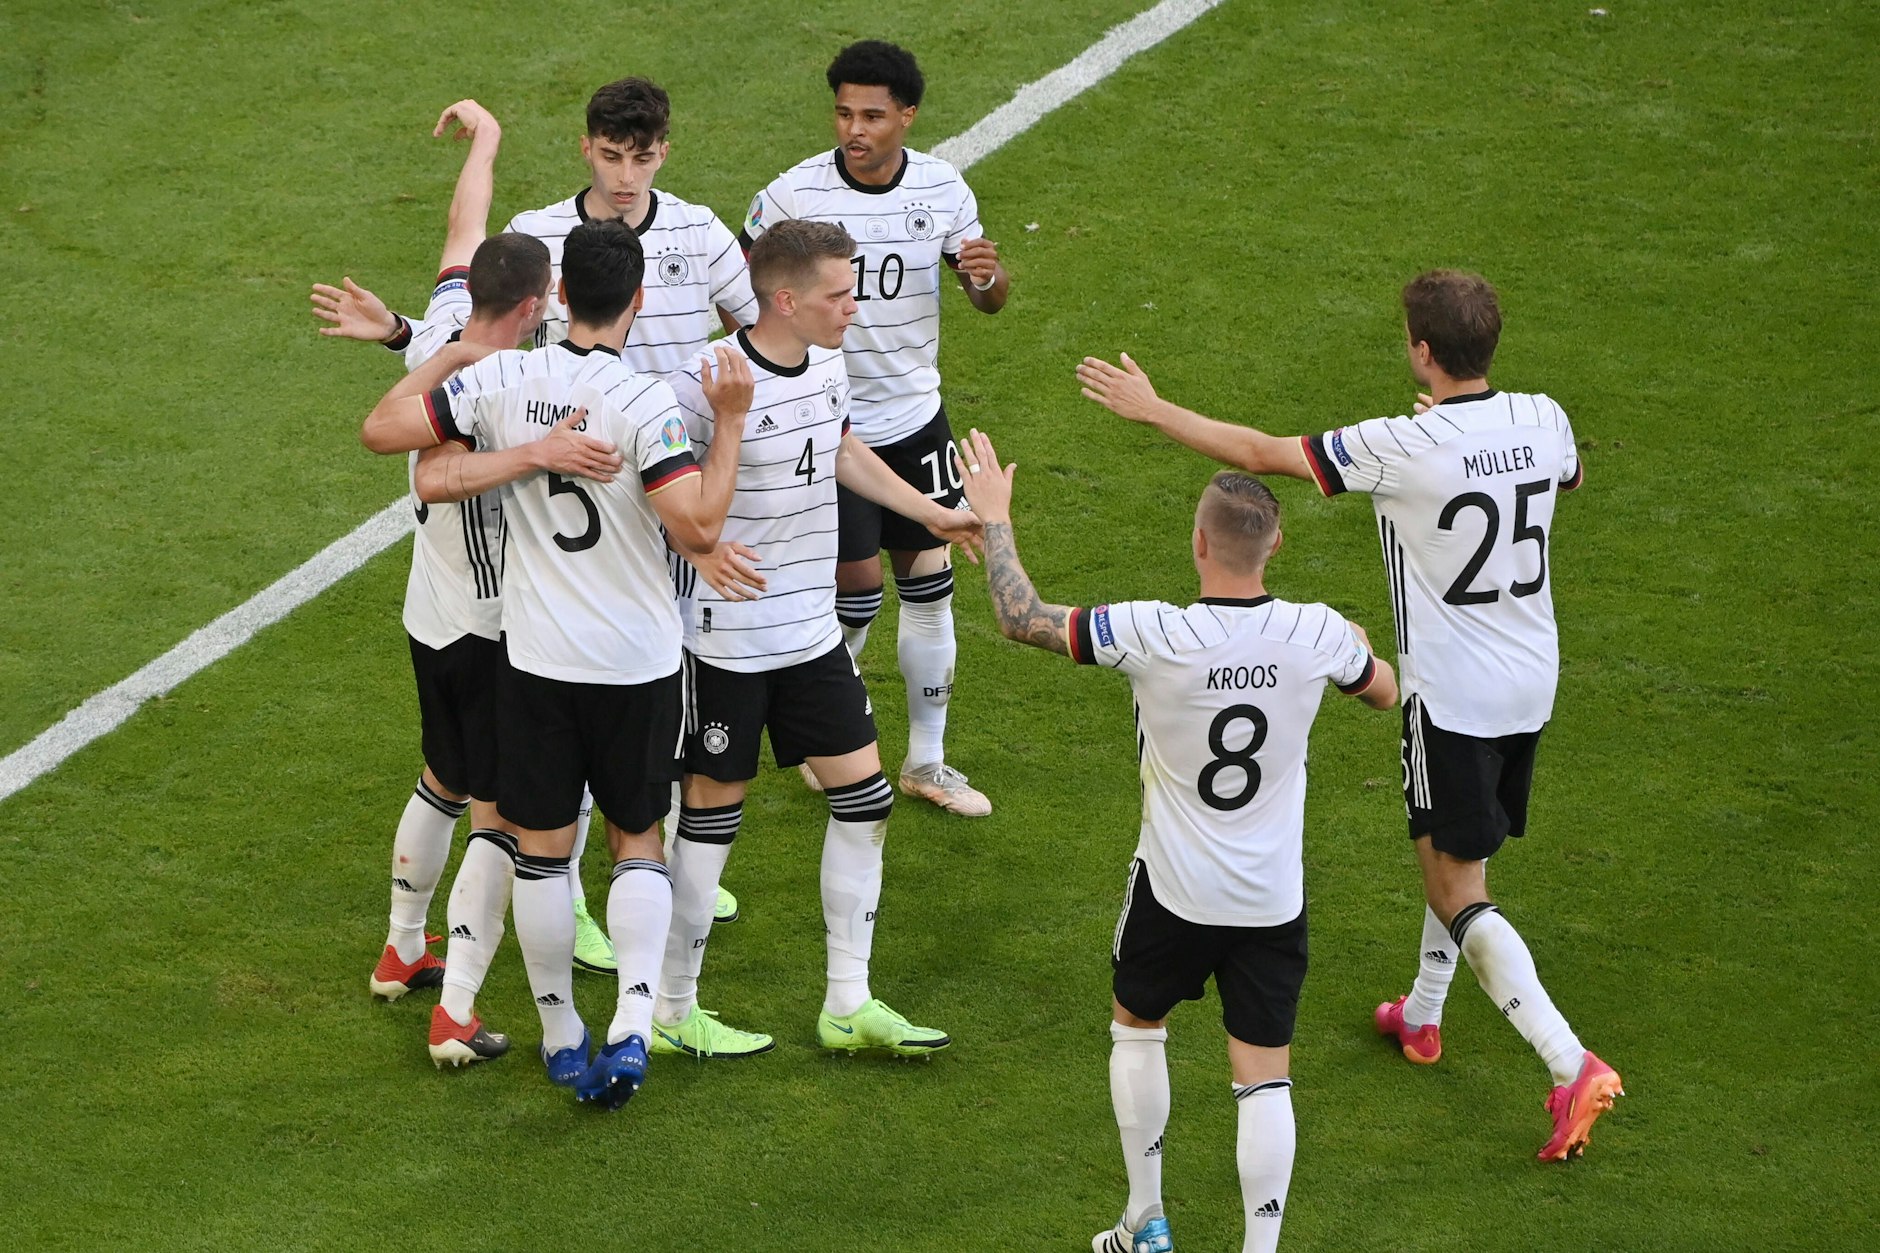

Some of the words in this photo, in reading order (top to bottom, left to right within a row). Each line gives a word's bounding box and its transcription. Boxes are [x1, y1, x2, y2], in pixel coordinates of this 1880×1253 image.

[850, 253, 904, 301] 10
[526, 399, 589, 432] HUMS
[755, 425, 779, 434] adidas
[795, 437, 816, 486] 4
[1334, 436, 1349, 465] RESPECT
[1463, 445, 1536, 479] MÜLLER
[921, 440, 964, 499] 10
[549, 471, 601, 552] 5
[1437, 478, 1551, 605] 25
[1098, 613, 1111, 645] RESPECT
[1206, 664, 1278, 690] KROOS
[1198, 703, 1268, 811] 8
[536, 998, 565, 1006] adidas
[625, 988, 653, 1000] adidas
[1502, 997, 1521, 1017] FB
[558, 1070, 580, 1081] COPA
[621, 1056, 643, 1067] COPA
[1254, 1210, 1282, 1218] adidas
